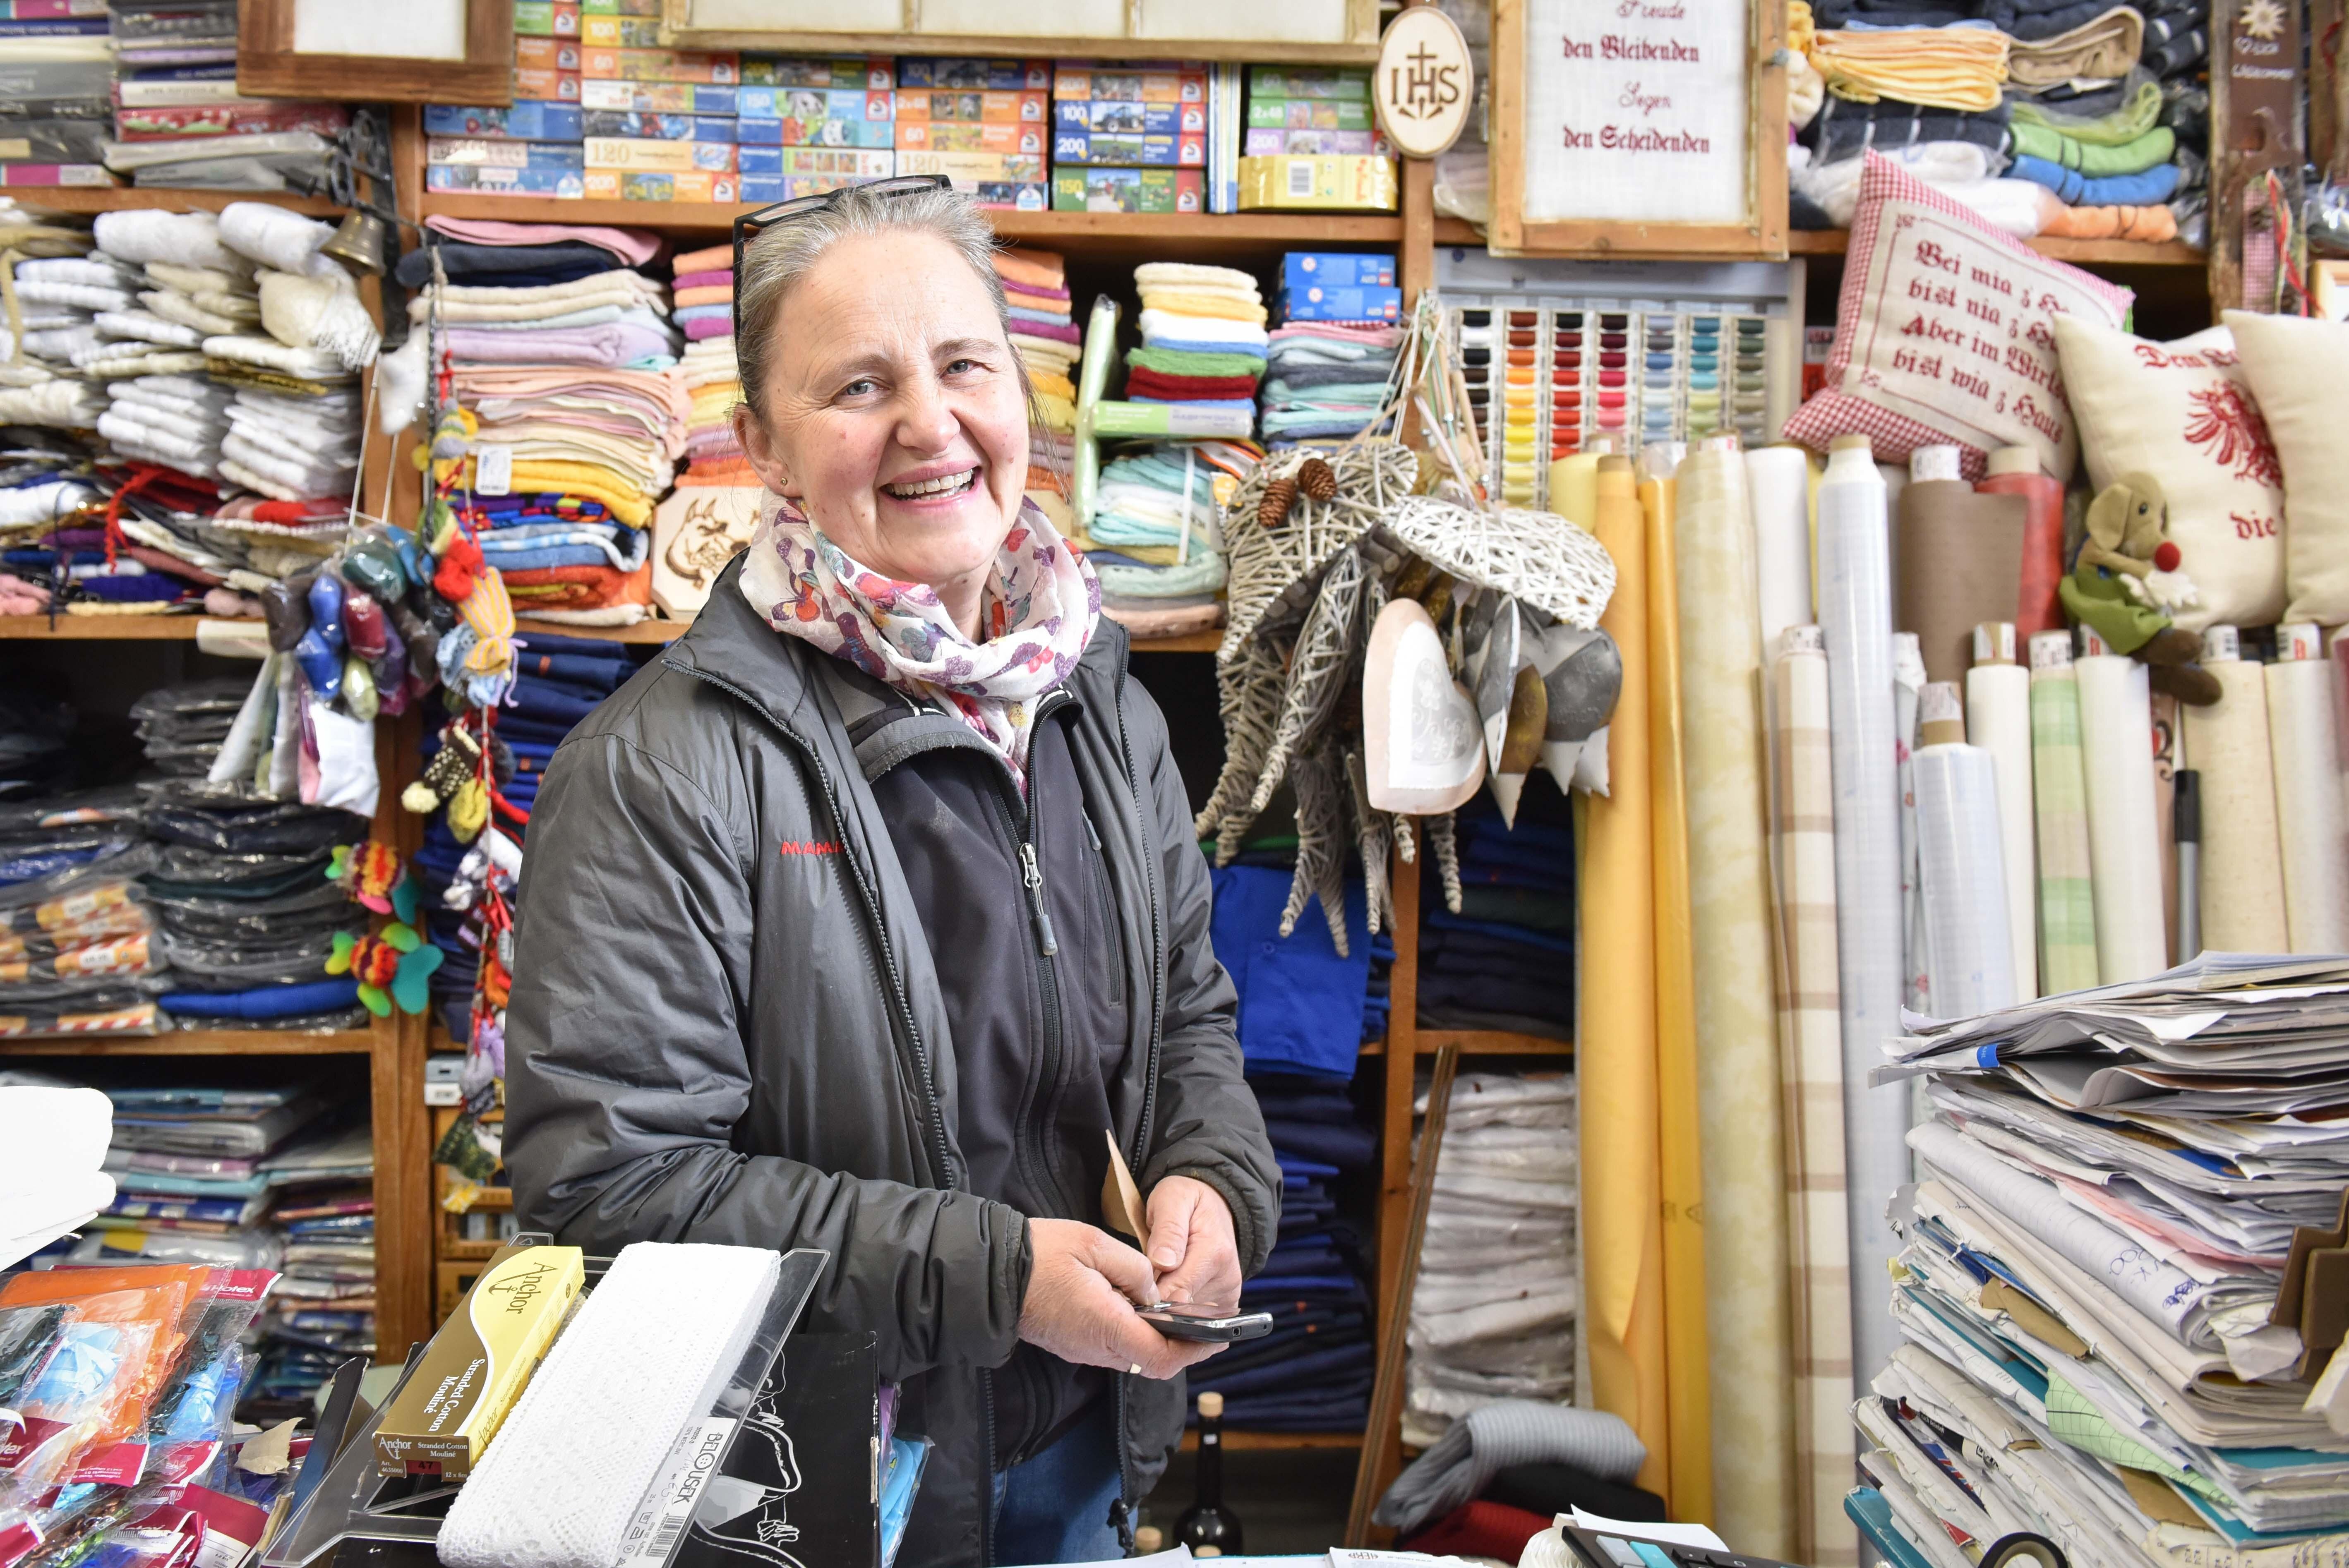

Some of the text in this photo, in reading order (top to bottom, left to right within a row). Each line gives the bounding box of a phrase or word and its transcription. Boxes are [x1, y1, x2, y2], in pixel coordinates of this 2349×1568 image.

[590, 22, 615, 37] 100
[1563, 34, 1699, 62] den Bleibenden
[1391, 64, 1459, 104] IHS
[1063, 105, 1088, 121] 100
[1618, 81, 1672, 117] Segen
[905, 127, 925, 142] 60
[1057, 137, 1086, 153] 200
[1563, 124, 1710, 156] den Scheidenden
[592, 143, 630, 162] 120
[903, 154, 941, 173] 120
[1916, 240, 1962, 275] Bei
[1908, 273, 1958, 308] bist
[1901, 312, 1965, 347] Aber
[1971, 331, 2000, 363] im
[1892, 348, 1944, 379] bist
[2013, 393, 2065, 445] Haus
[2230, 511, 2277, 539] die
[211, 1284, 258, 1293] Hotex
[489, 1262, 558, 1314] Anchor
[423, 1375, 460, 1413] Mouliné
[428, 1359, 486, 1432] Stranded Cotton
[379, 1437, 412, 1457] Anchor
[418, 1461, 433, 1469] 47
